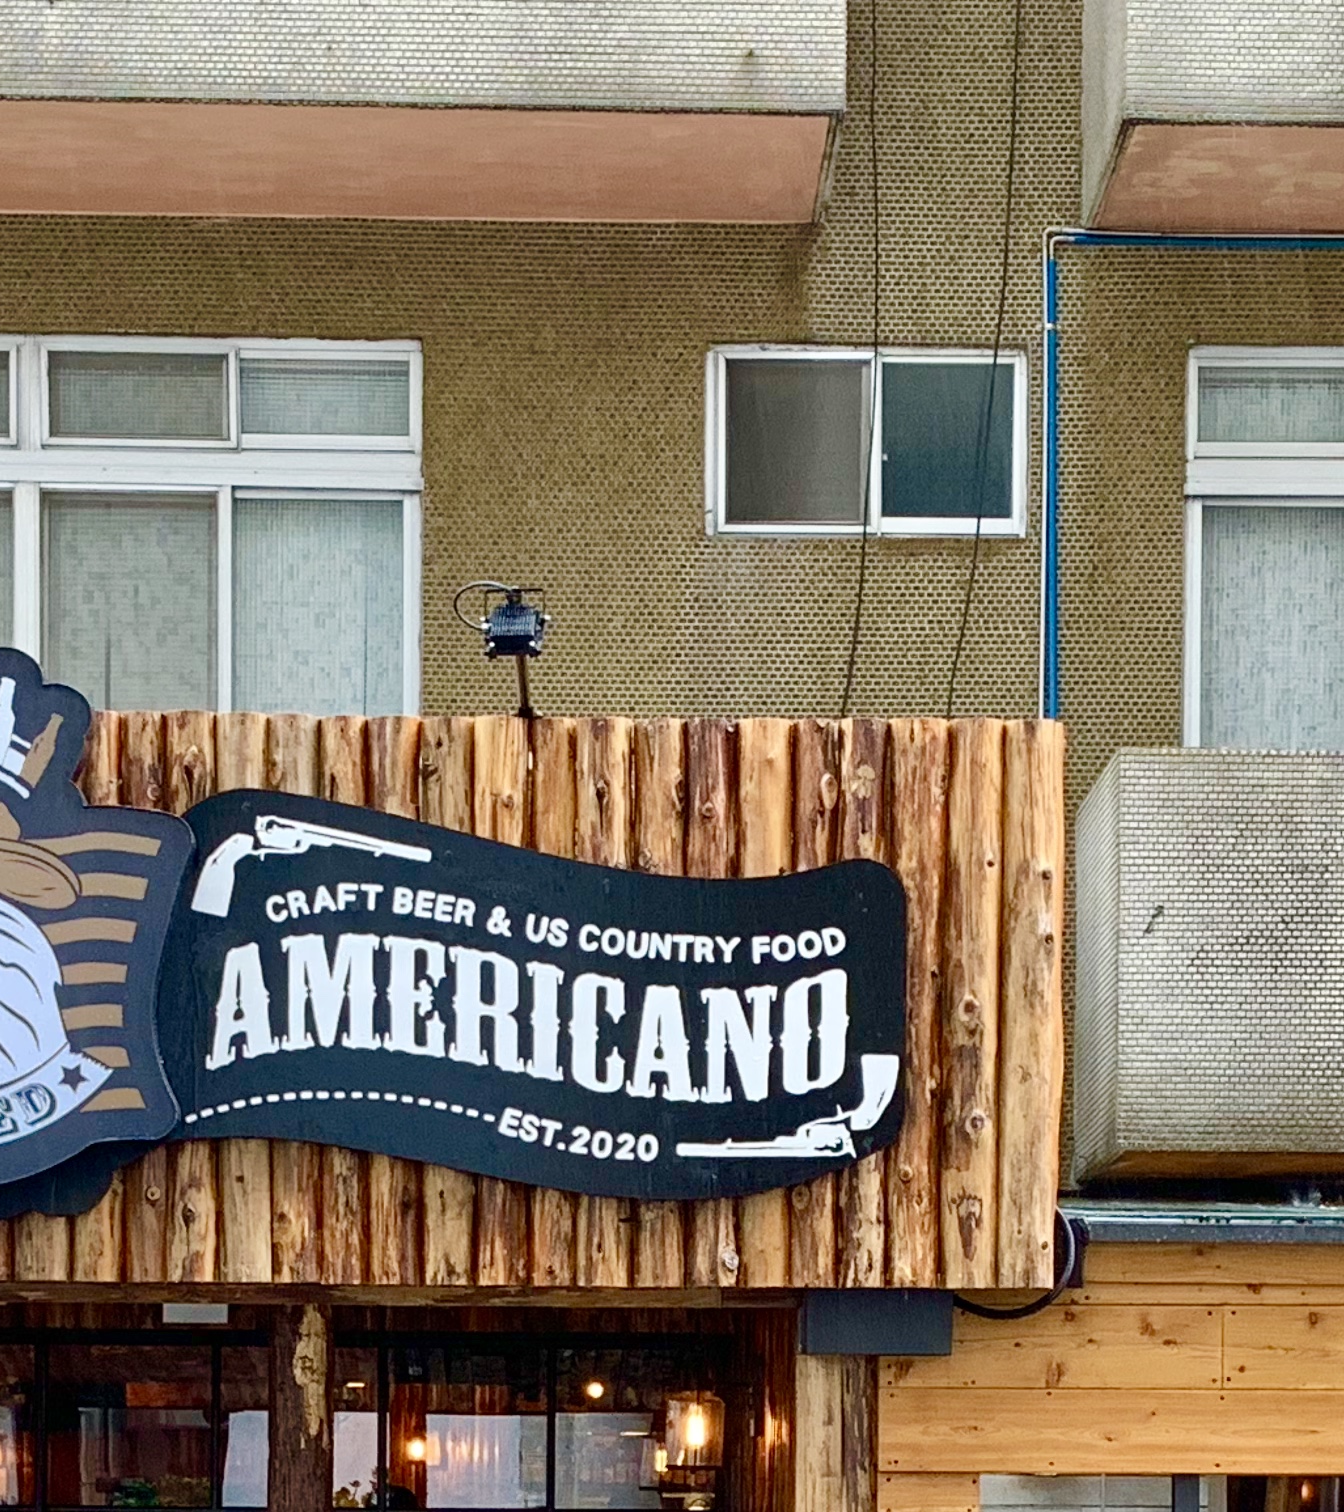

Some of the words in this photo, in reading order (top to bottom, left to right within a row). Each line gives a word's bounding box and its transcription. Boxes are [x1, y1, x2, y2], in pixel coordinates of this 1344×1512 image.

[265, 883, 383, 924] CRAFT
[392, 885, 476, 927] BEER
[485, 907, 511, 936] &
[525, 913, 570, 949] US
[578, 923, 742, 965] COUNTRY
[751, 926, 847, 965] FOOD
[205, 932, 850, 1105] AMERICANO
[497, 1108, 659, 1163] EST.2020
